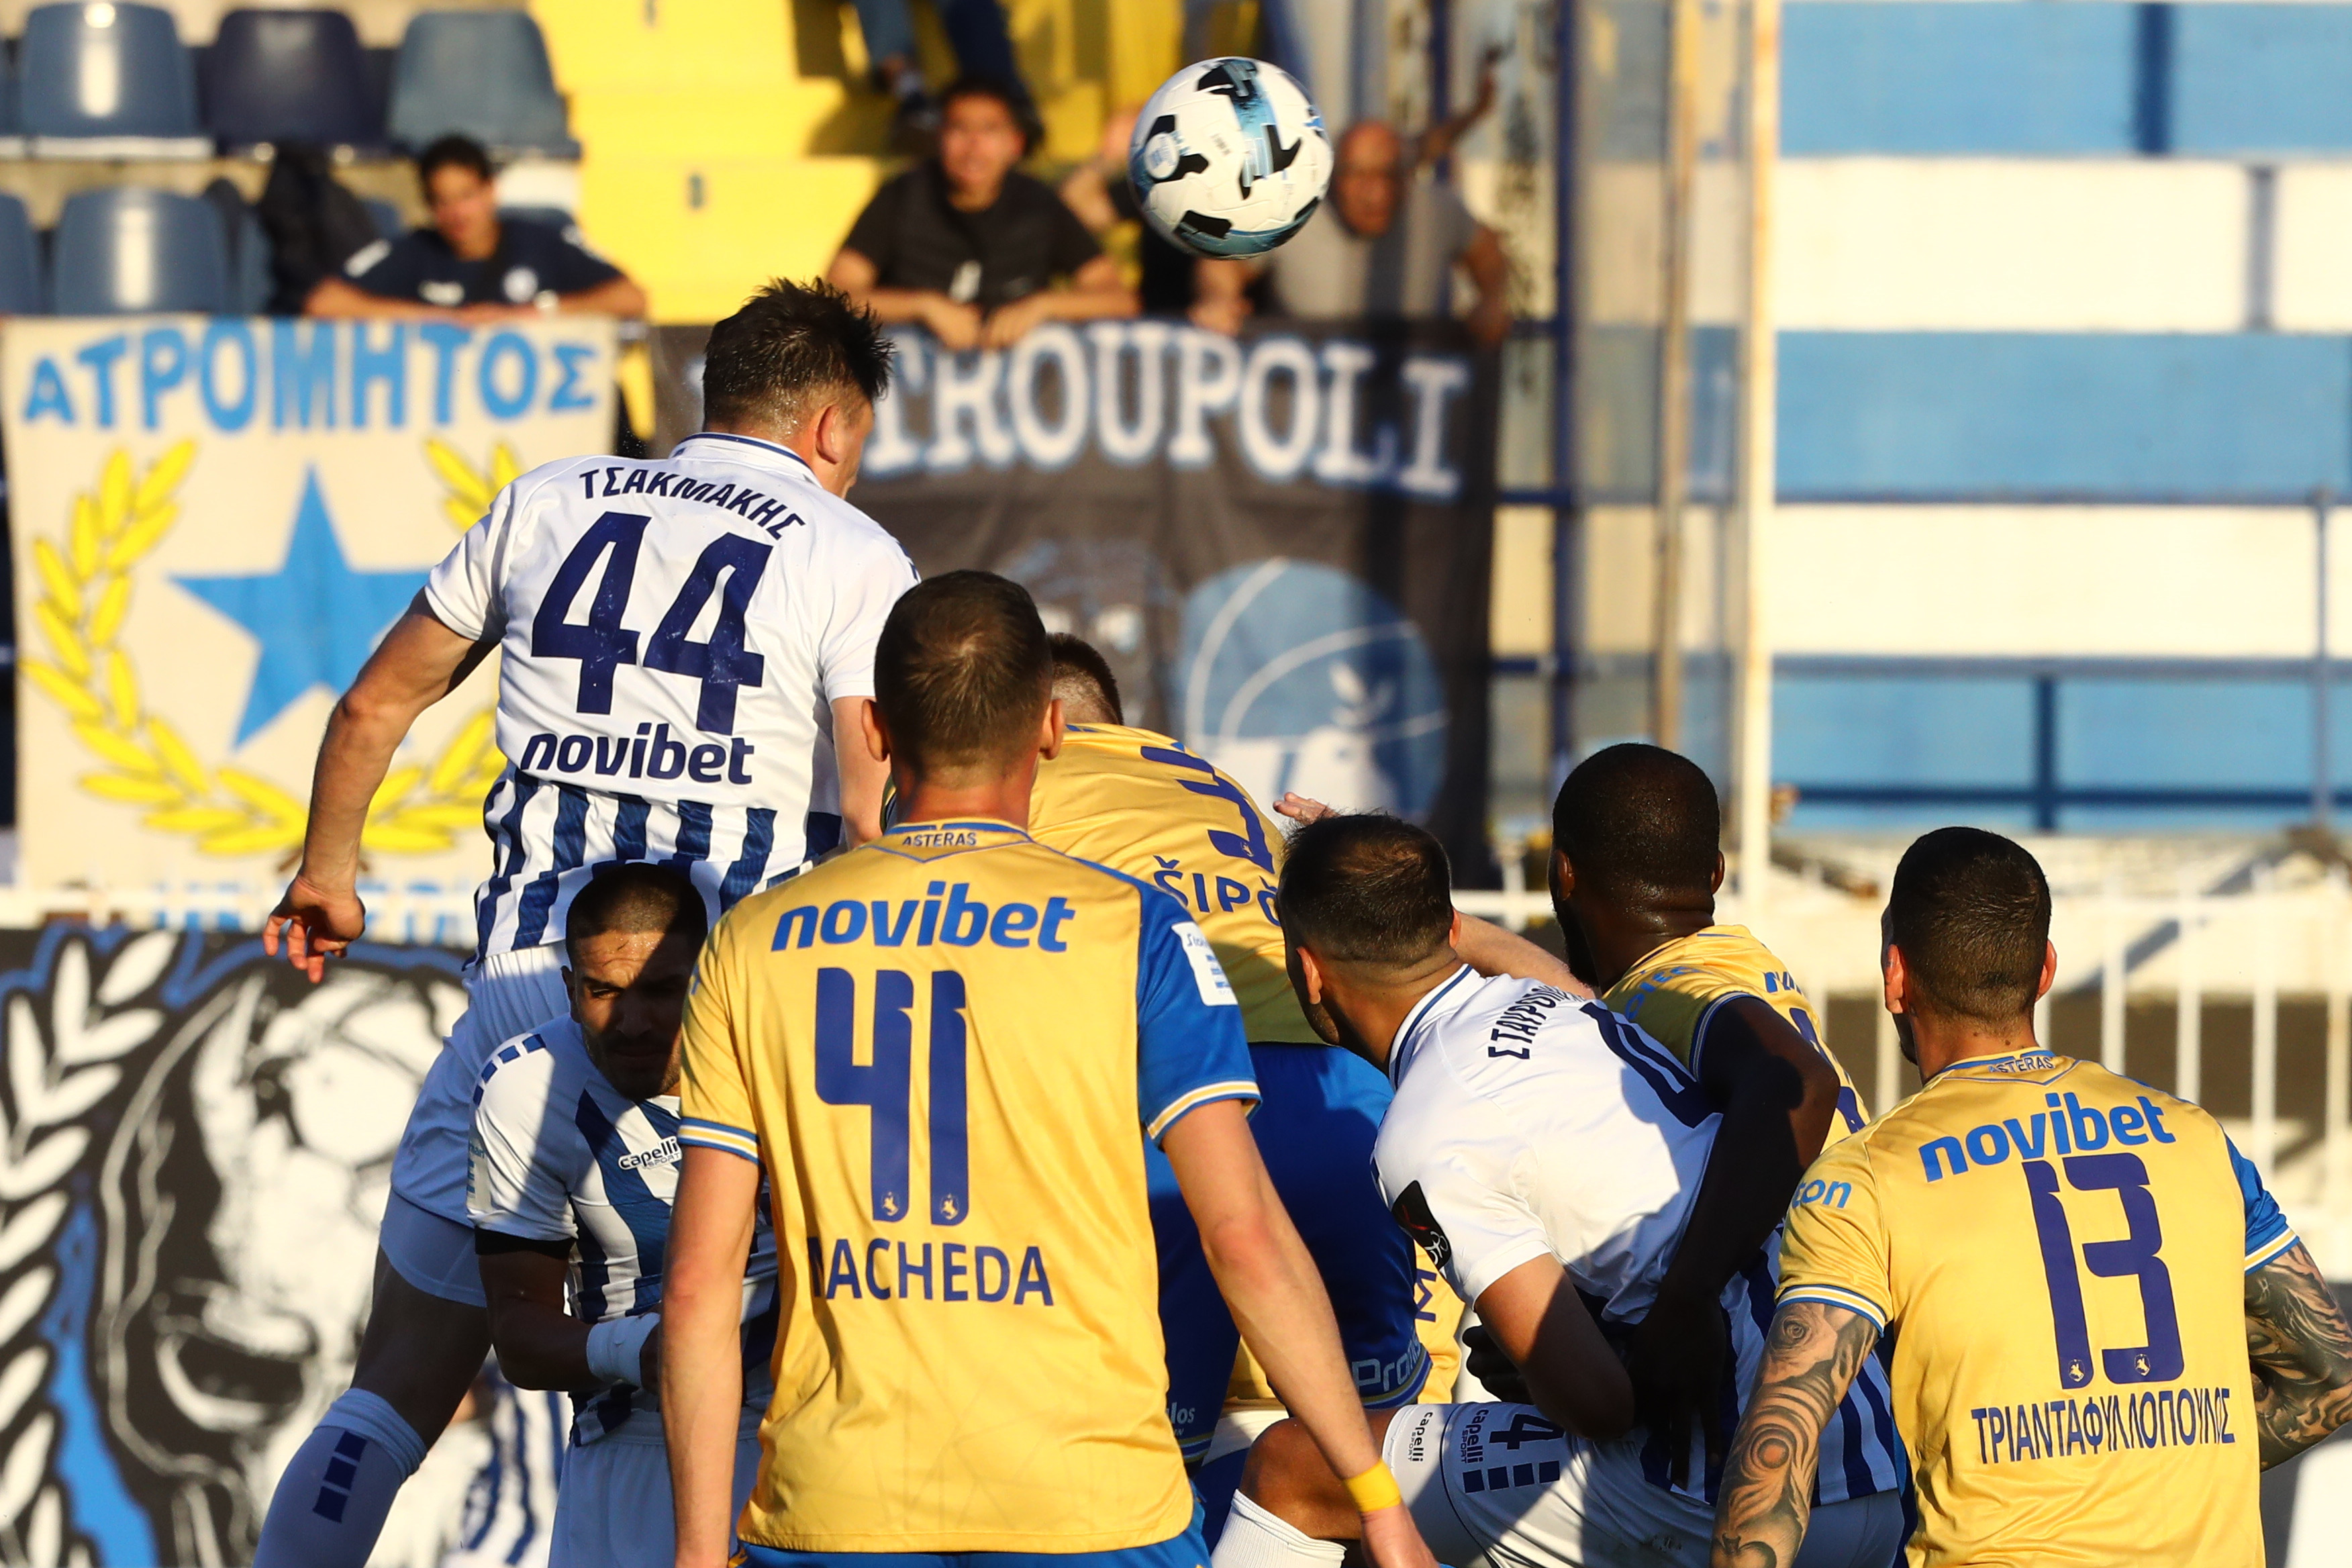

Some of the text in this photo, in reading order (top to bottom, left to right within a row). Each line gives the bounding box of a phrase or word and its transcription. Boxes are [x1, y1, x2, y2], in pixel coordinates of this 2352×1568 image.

[22, 318, 599, 432] ΑΤΡΟΜΗΤΟΣ
[687, 321, 1470, 495] TROUPOLI
[579, 466, 806, 540] ΤΣΑΚΜΑΚΗΣ
[530, 511, 774, 736] 44
[520, 722, 754, 785] novibet
[902, 832, 977, 846] ASTERAS
[771, 879, 1076, 953] novibet
[814, 967, 970, 1226] 41
[1989, 1057, 2055, 1073] ASTERAS
[620, 1138, 678, 1169] capelli
[647, 1153, 680, 1167] SPORT
[1918, 1092, 2177, 1183] novibet
[1792, 1179, 1851, 1209] ton
[2021, 1152, 2185, 1389] 13
[1412, 1412, 1433, 1462] capelli
[1466, 1409, 1489, 1464] capelli
[1489, 1413, 1566, 1451] 4
